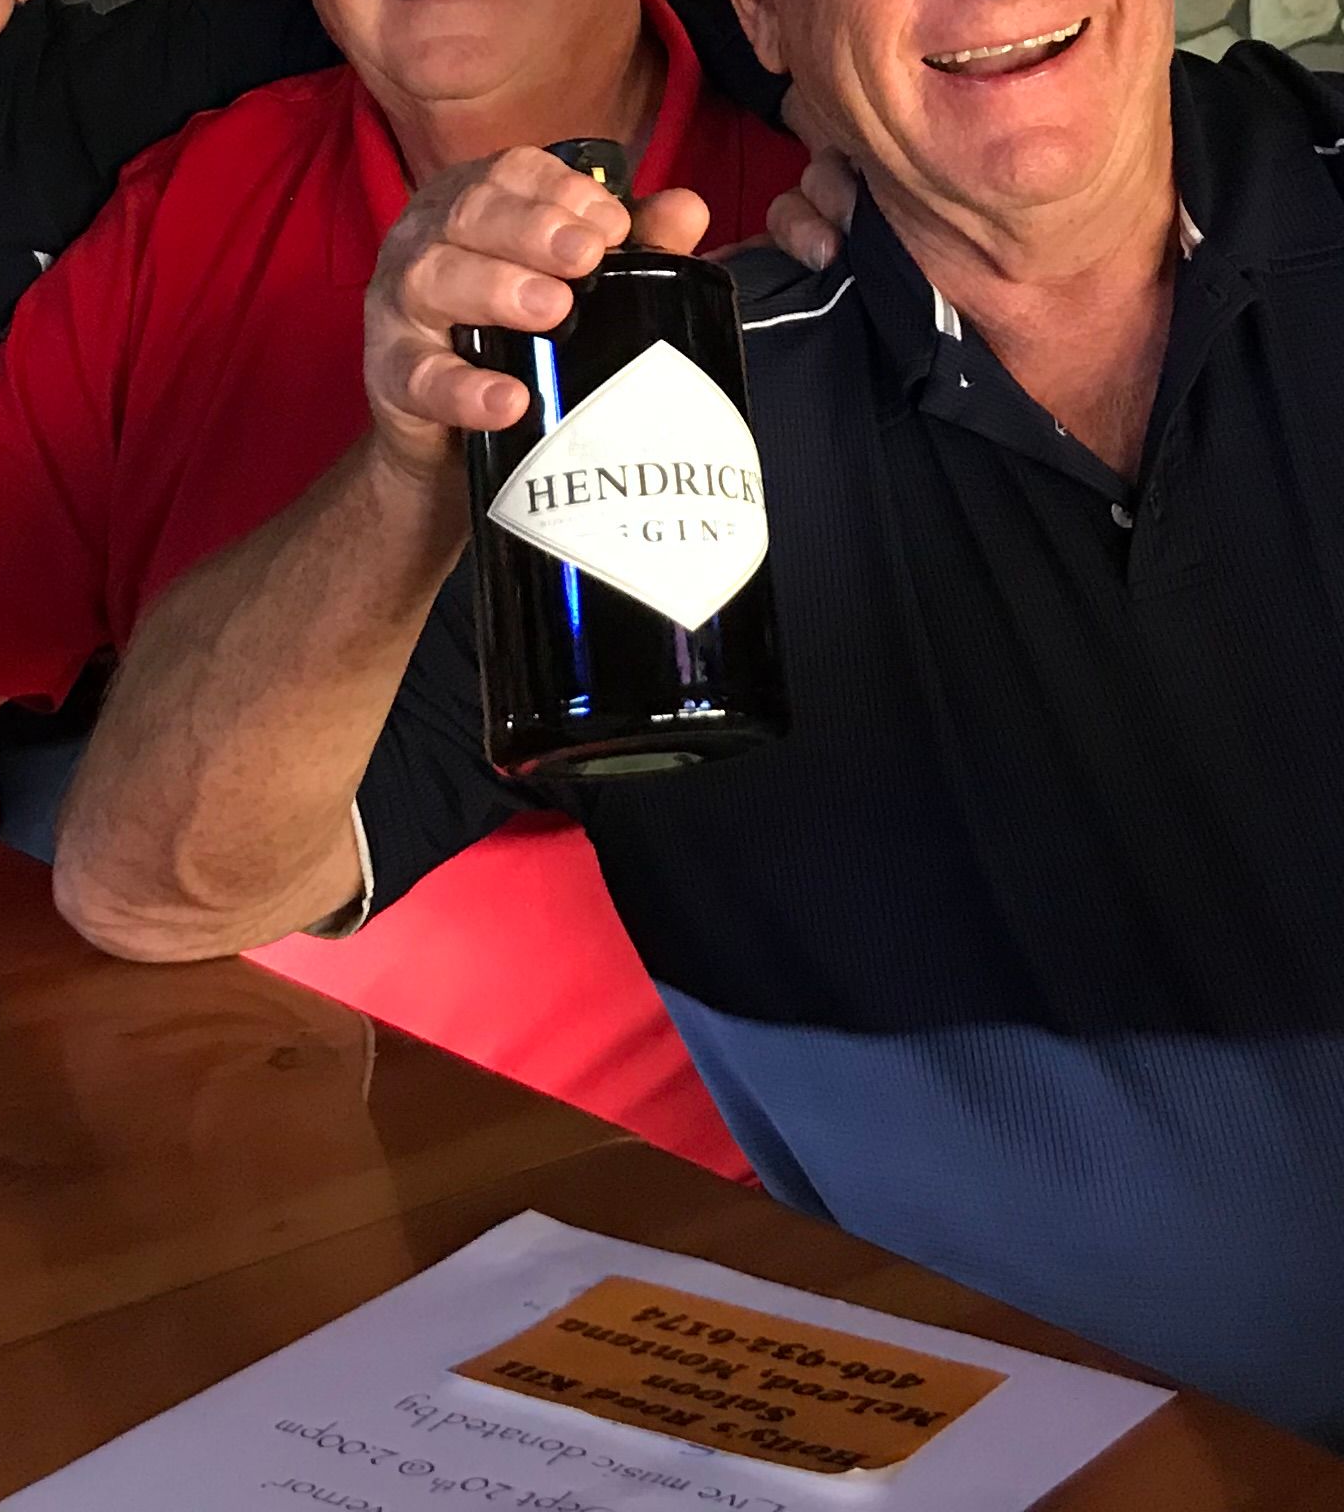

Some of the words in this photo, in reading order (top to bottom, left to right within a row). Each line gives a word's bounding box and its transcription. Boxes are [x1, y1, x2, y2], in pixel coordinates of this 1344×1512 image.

[642, 519, 721, 542] GIN
[556, 1316, 748, 1381] Montana
[493, 1360, 582, 1393] Kill
[394, 1392, 430, 1429] by
[581, 1388, 704, 1428] Road
[640, 1374, 796, 1424] Saloon
[428, 1412, 588, 1466] donated
[711, 1420, 870, 1471] Holly's
[397, 1458, 436, 1477] @
[591, 1455, 692, 1495] music
